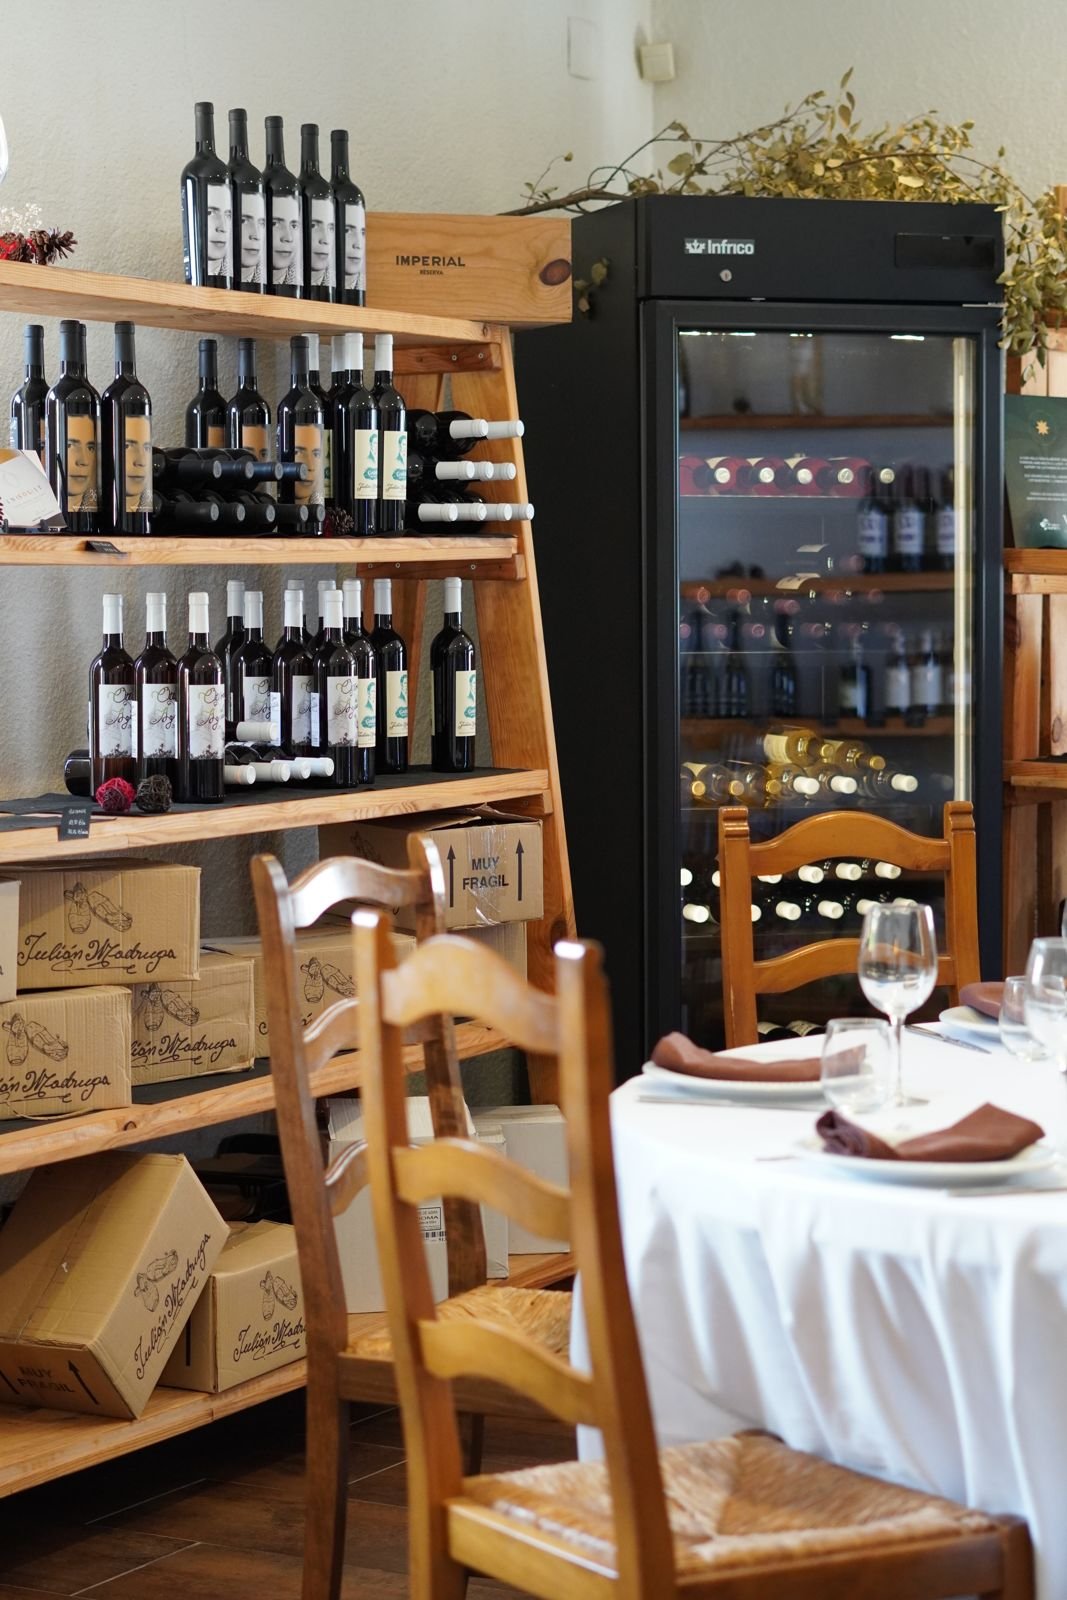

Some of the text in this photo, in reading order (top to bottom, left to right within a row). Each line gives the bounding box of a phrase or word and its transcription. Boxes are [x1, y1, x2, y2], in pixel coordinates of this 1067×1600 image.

[395, 255, 466, 267] IMPERIAL
[707, 239, 754, 255] Infrico
[471, 856, 500, 871] MUY
[462, 874, 509, 890] FRAGIL
[17, 932, 177, 973] Julián Madruga
[158, 1032, 237, 1062] Madruga
[22, 1068, 111, 1101] Madruga
[135, 1233, 211, 1380] Julián Madruga
[233, 1324, 271, 1362] Julián
